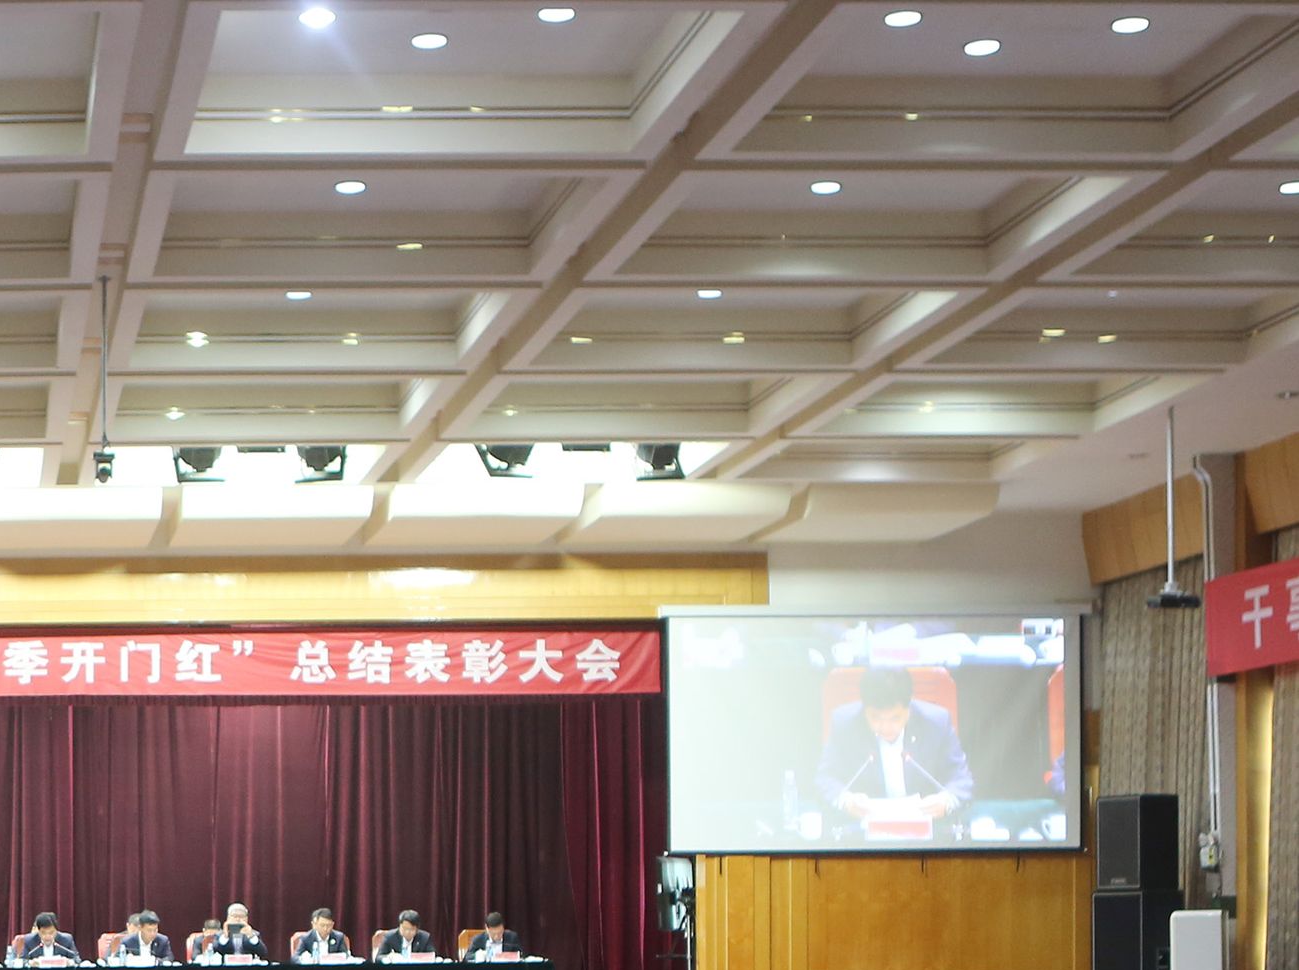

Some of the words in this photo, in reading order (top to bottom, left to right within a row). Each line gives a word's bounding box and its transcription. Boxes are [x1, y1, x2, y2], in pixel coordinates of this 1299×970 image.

[290, 639, 621, 684] 总结表彰大会
